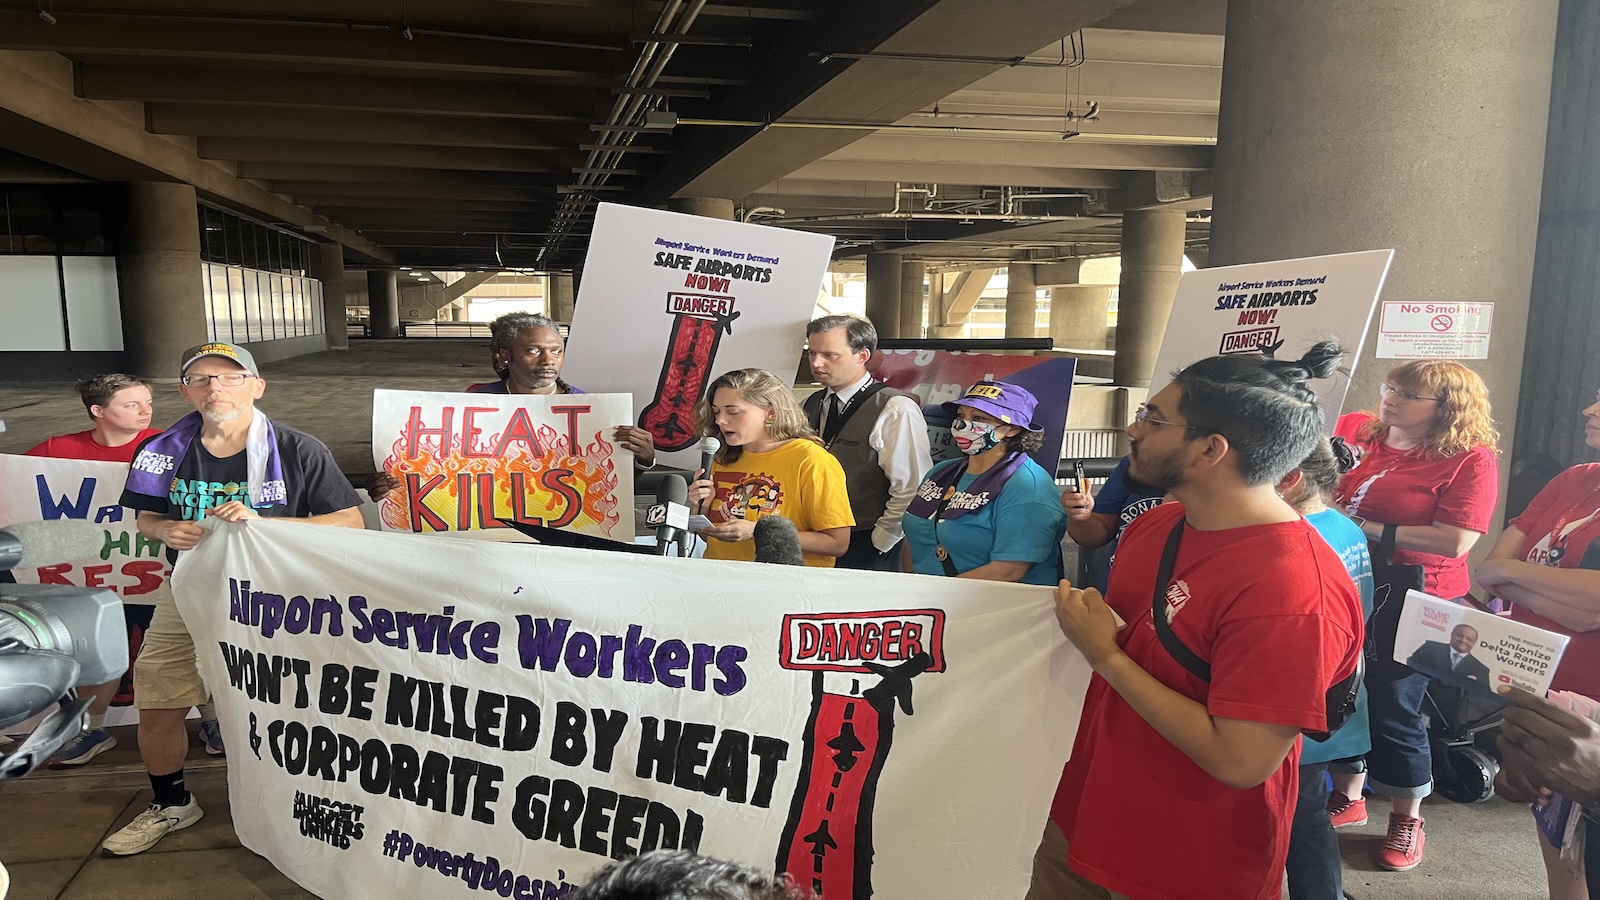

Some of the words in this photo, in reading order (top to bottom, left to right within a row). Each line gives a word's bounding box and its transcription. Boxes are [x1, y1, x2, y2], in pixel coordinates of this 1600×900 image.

[654, 237, 683, 250] Airport
[683, 242, 711, 254] Service
[712, 247, 745, 260] Workers
[746, 253, 780, 266] Demand
[654, 252, 694, 270] SAFE
[694, 258, 772, 283] AIRPORTS
[684, 272, 731, 294] NOW!
[1218, 282, 1241, 292] Airport
[1240, 281, 1264, 290] Service
[1265, 278, 1294, 288] Workers
[1295, 275, 1328, 286] Demand
[673, 296, 728, 314] DANGER
[1214, 294, 1248, 310] SAFE
[1246, 288, 1318, 309] AIRPORTS
[1400, 304, 1421, 314] No
[1237, 308, 1279, 326] NOW!
[1225, 331, 1273, 350] DANGER
[406, 406, 592, 459] HEAT
[175, 478, 248, 496] AIRPOR
[406, 468, 582, 532] KILLS
[229, 578, 344, 638] Airport
[349, 596, 500, 664] Service
[515, 614, 748, 696] Workers
[796, 621, 922, 661] DANGER
[1480, 640, 1510, 656] Delta
[1514, 652, 1548, 670] Ramp
[1500, 640, 1552, 661] Unionize
[1496, 654, 1546, 676] Workers
[218, 642, 310, 708] WON'T
[319, 663, 380, 721] BE
[385, 672, 540, 751] KILLED
[550, 701, 628, 773] BY
[635, 716, 790, 808] HEAT
[250, 711, 262, 760] &
[268, 720, 504, 825] CORPORATE
